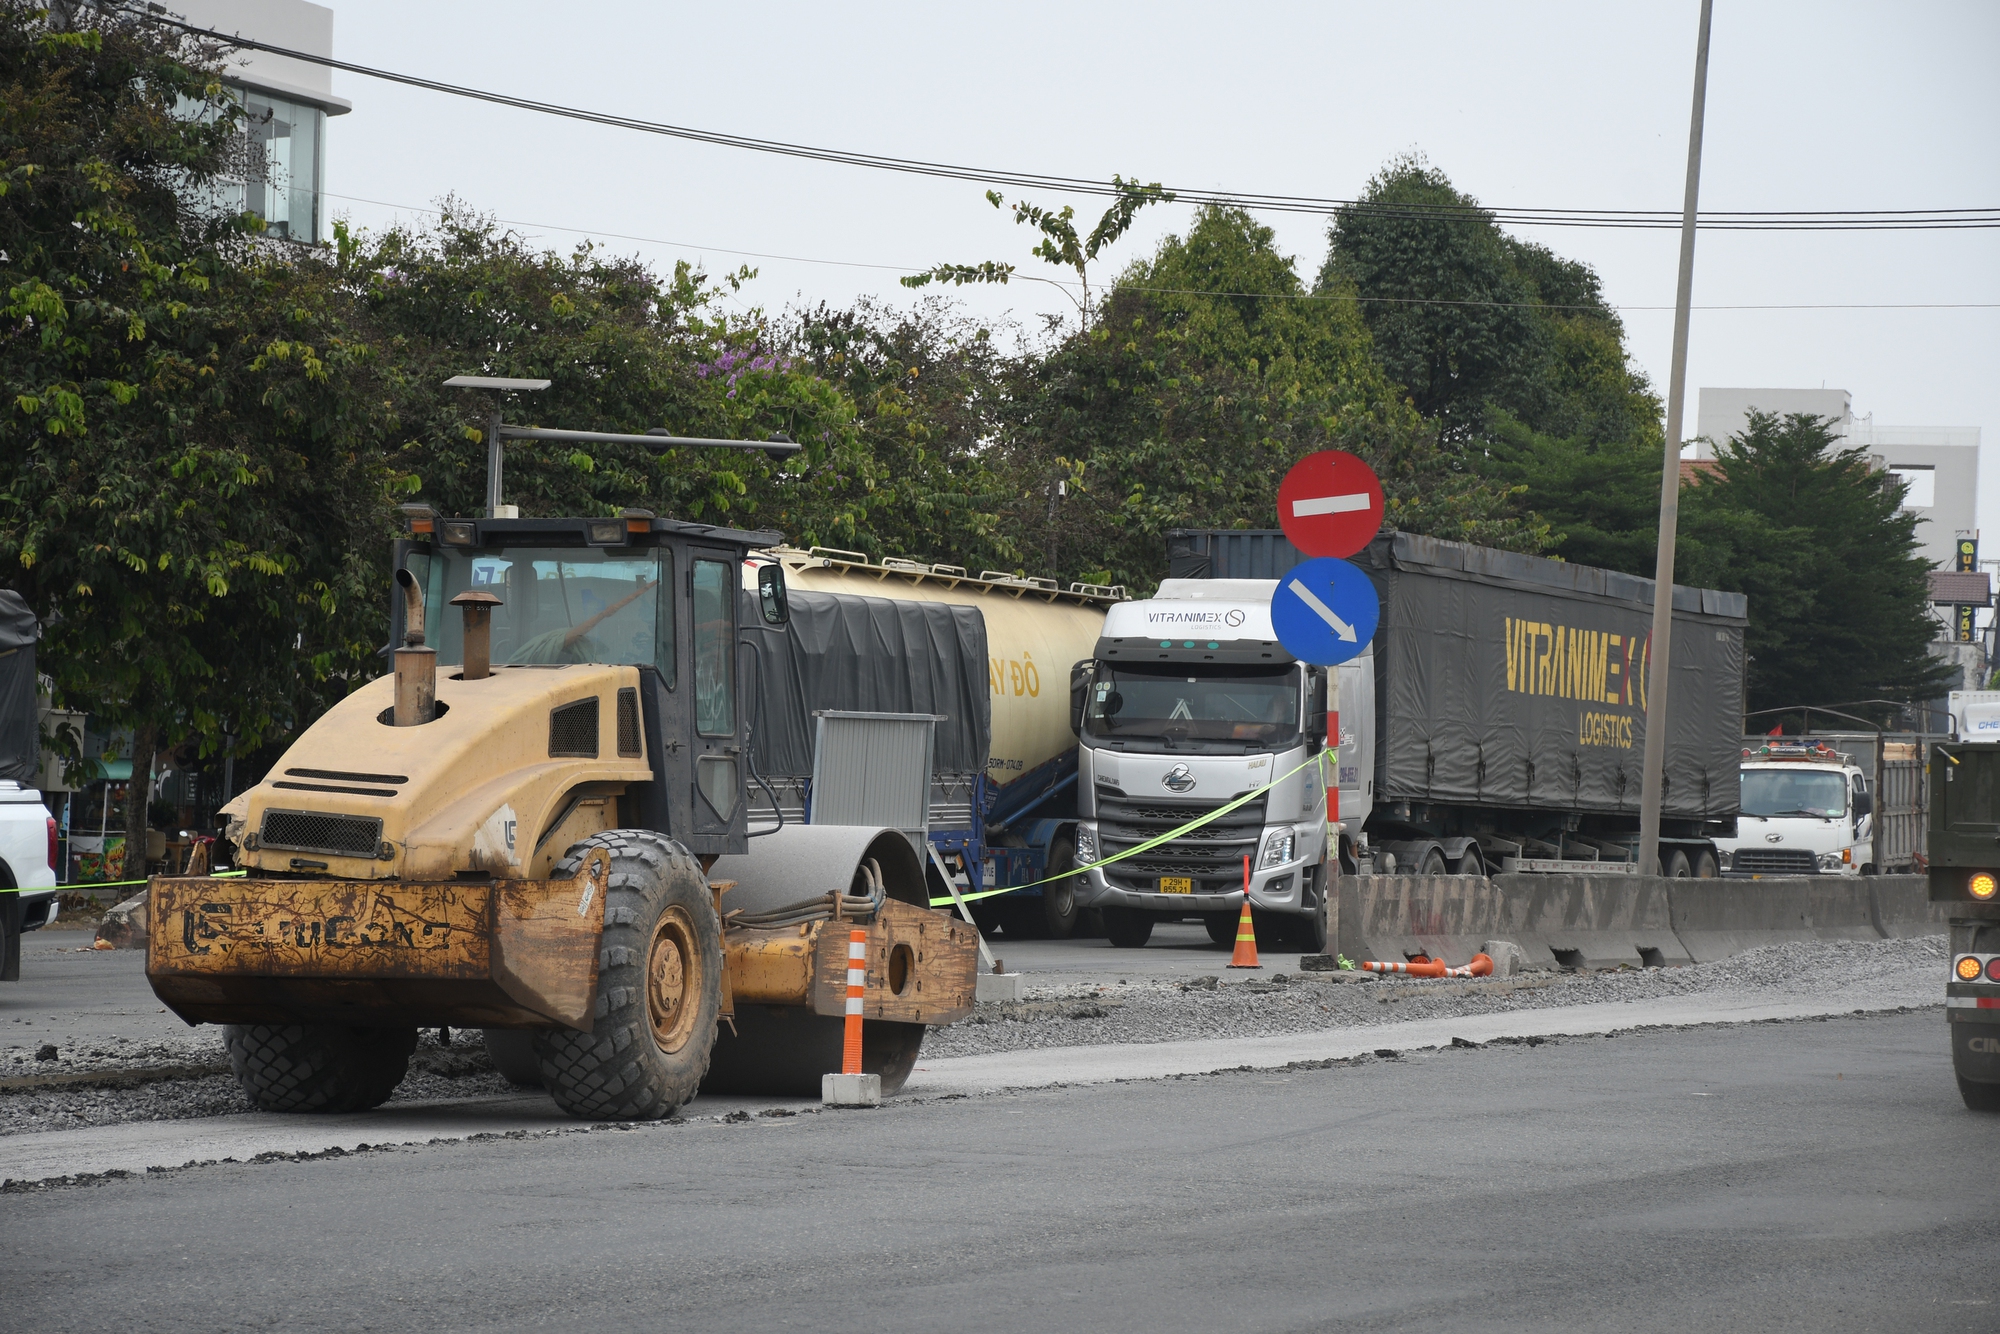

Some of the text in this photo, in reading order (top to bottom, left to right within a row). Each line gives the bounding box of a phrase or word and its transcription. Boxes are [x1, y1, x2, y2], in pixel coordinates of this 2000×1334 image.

[1149, 613, 1222, 623] VITRANIMEX
[1506, 617, 1636, 706] VITRANIMEX
[1010, 651, 1040, 698] ĐÔ
[1579, 712, 1632, 749] LOGISTICS
[1163, 885, 1188, 894] 855.21
[1168, 878, 1183, 886] 29H
